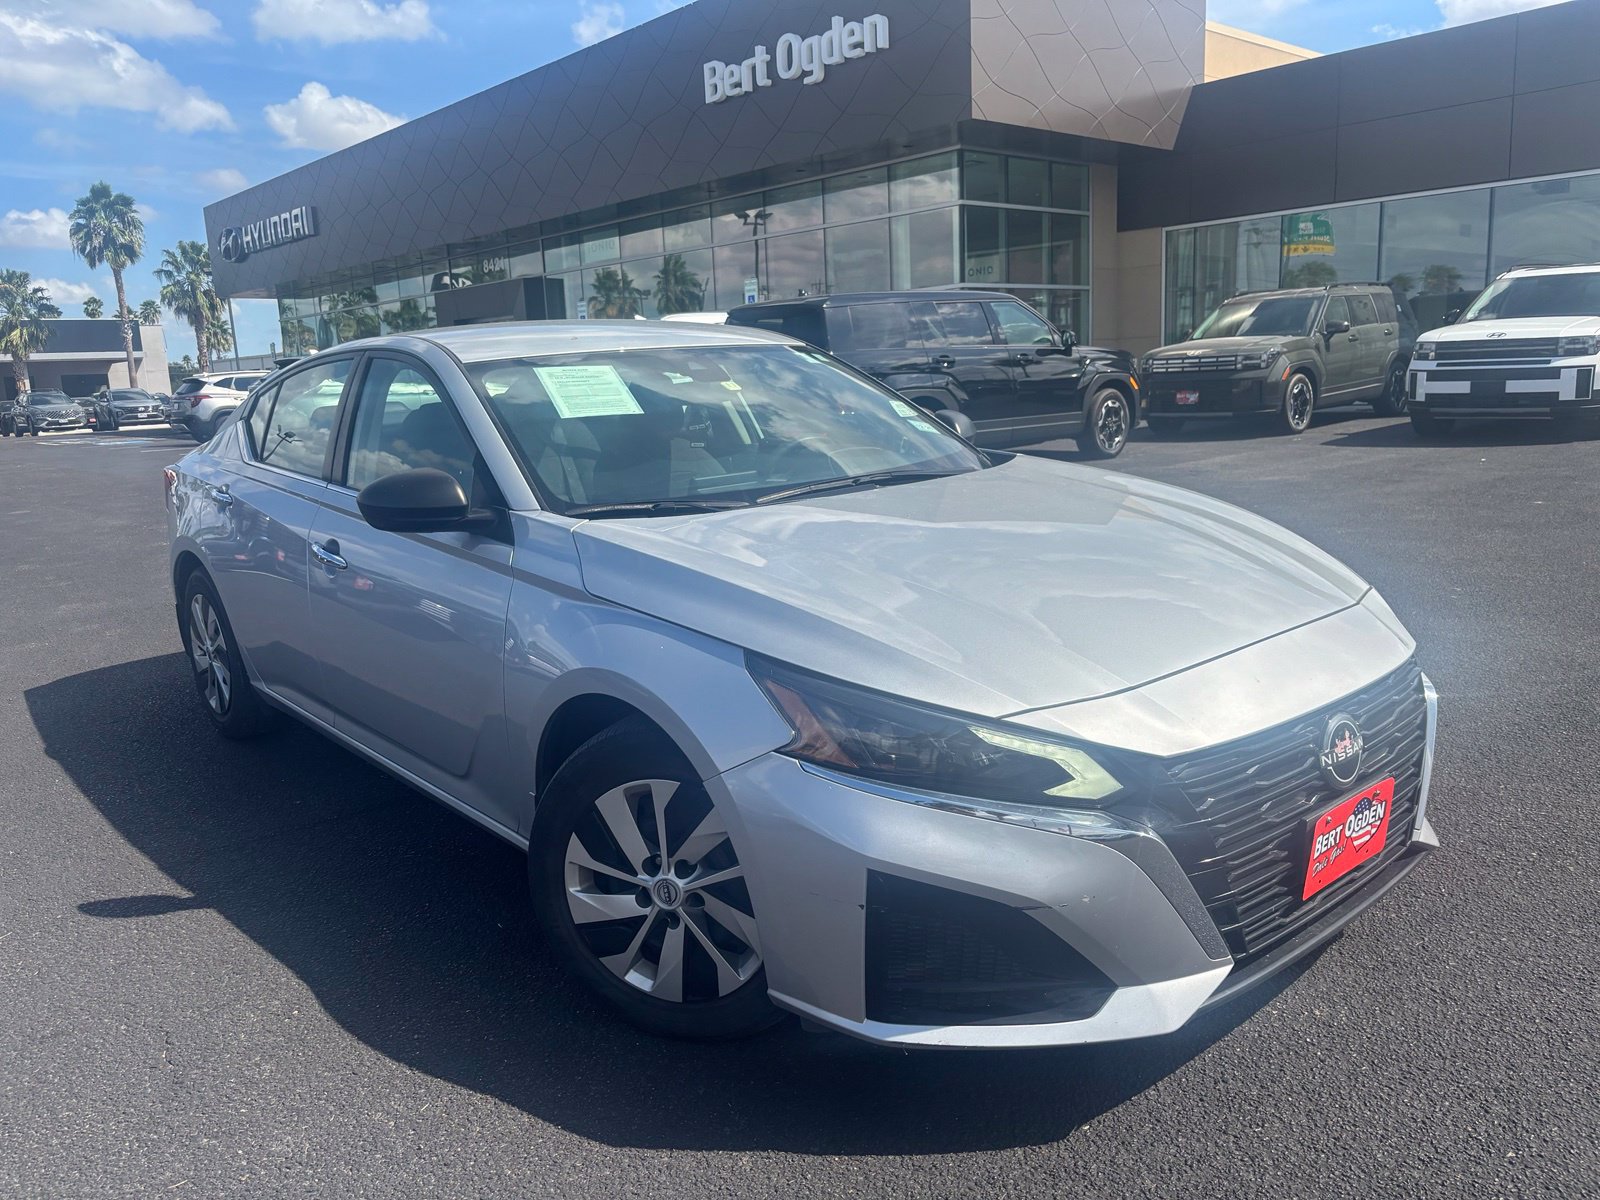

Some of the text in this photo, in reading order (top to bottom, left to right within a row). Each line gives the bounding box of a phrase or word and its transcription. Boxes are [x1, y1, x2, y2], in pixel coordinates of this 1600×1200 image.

[704, 14, 889, 103] Bert Ogden
[242, 206, 312, 253] HYUNDAI
[1321, 735, 1363, 766] NISSAN
[1313, 801, 1386, 860] BERT OGDEN
